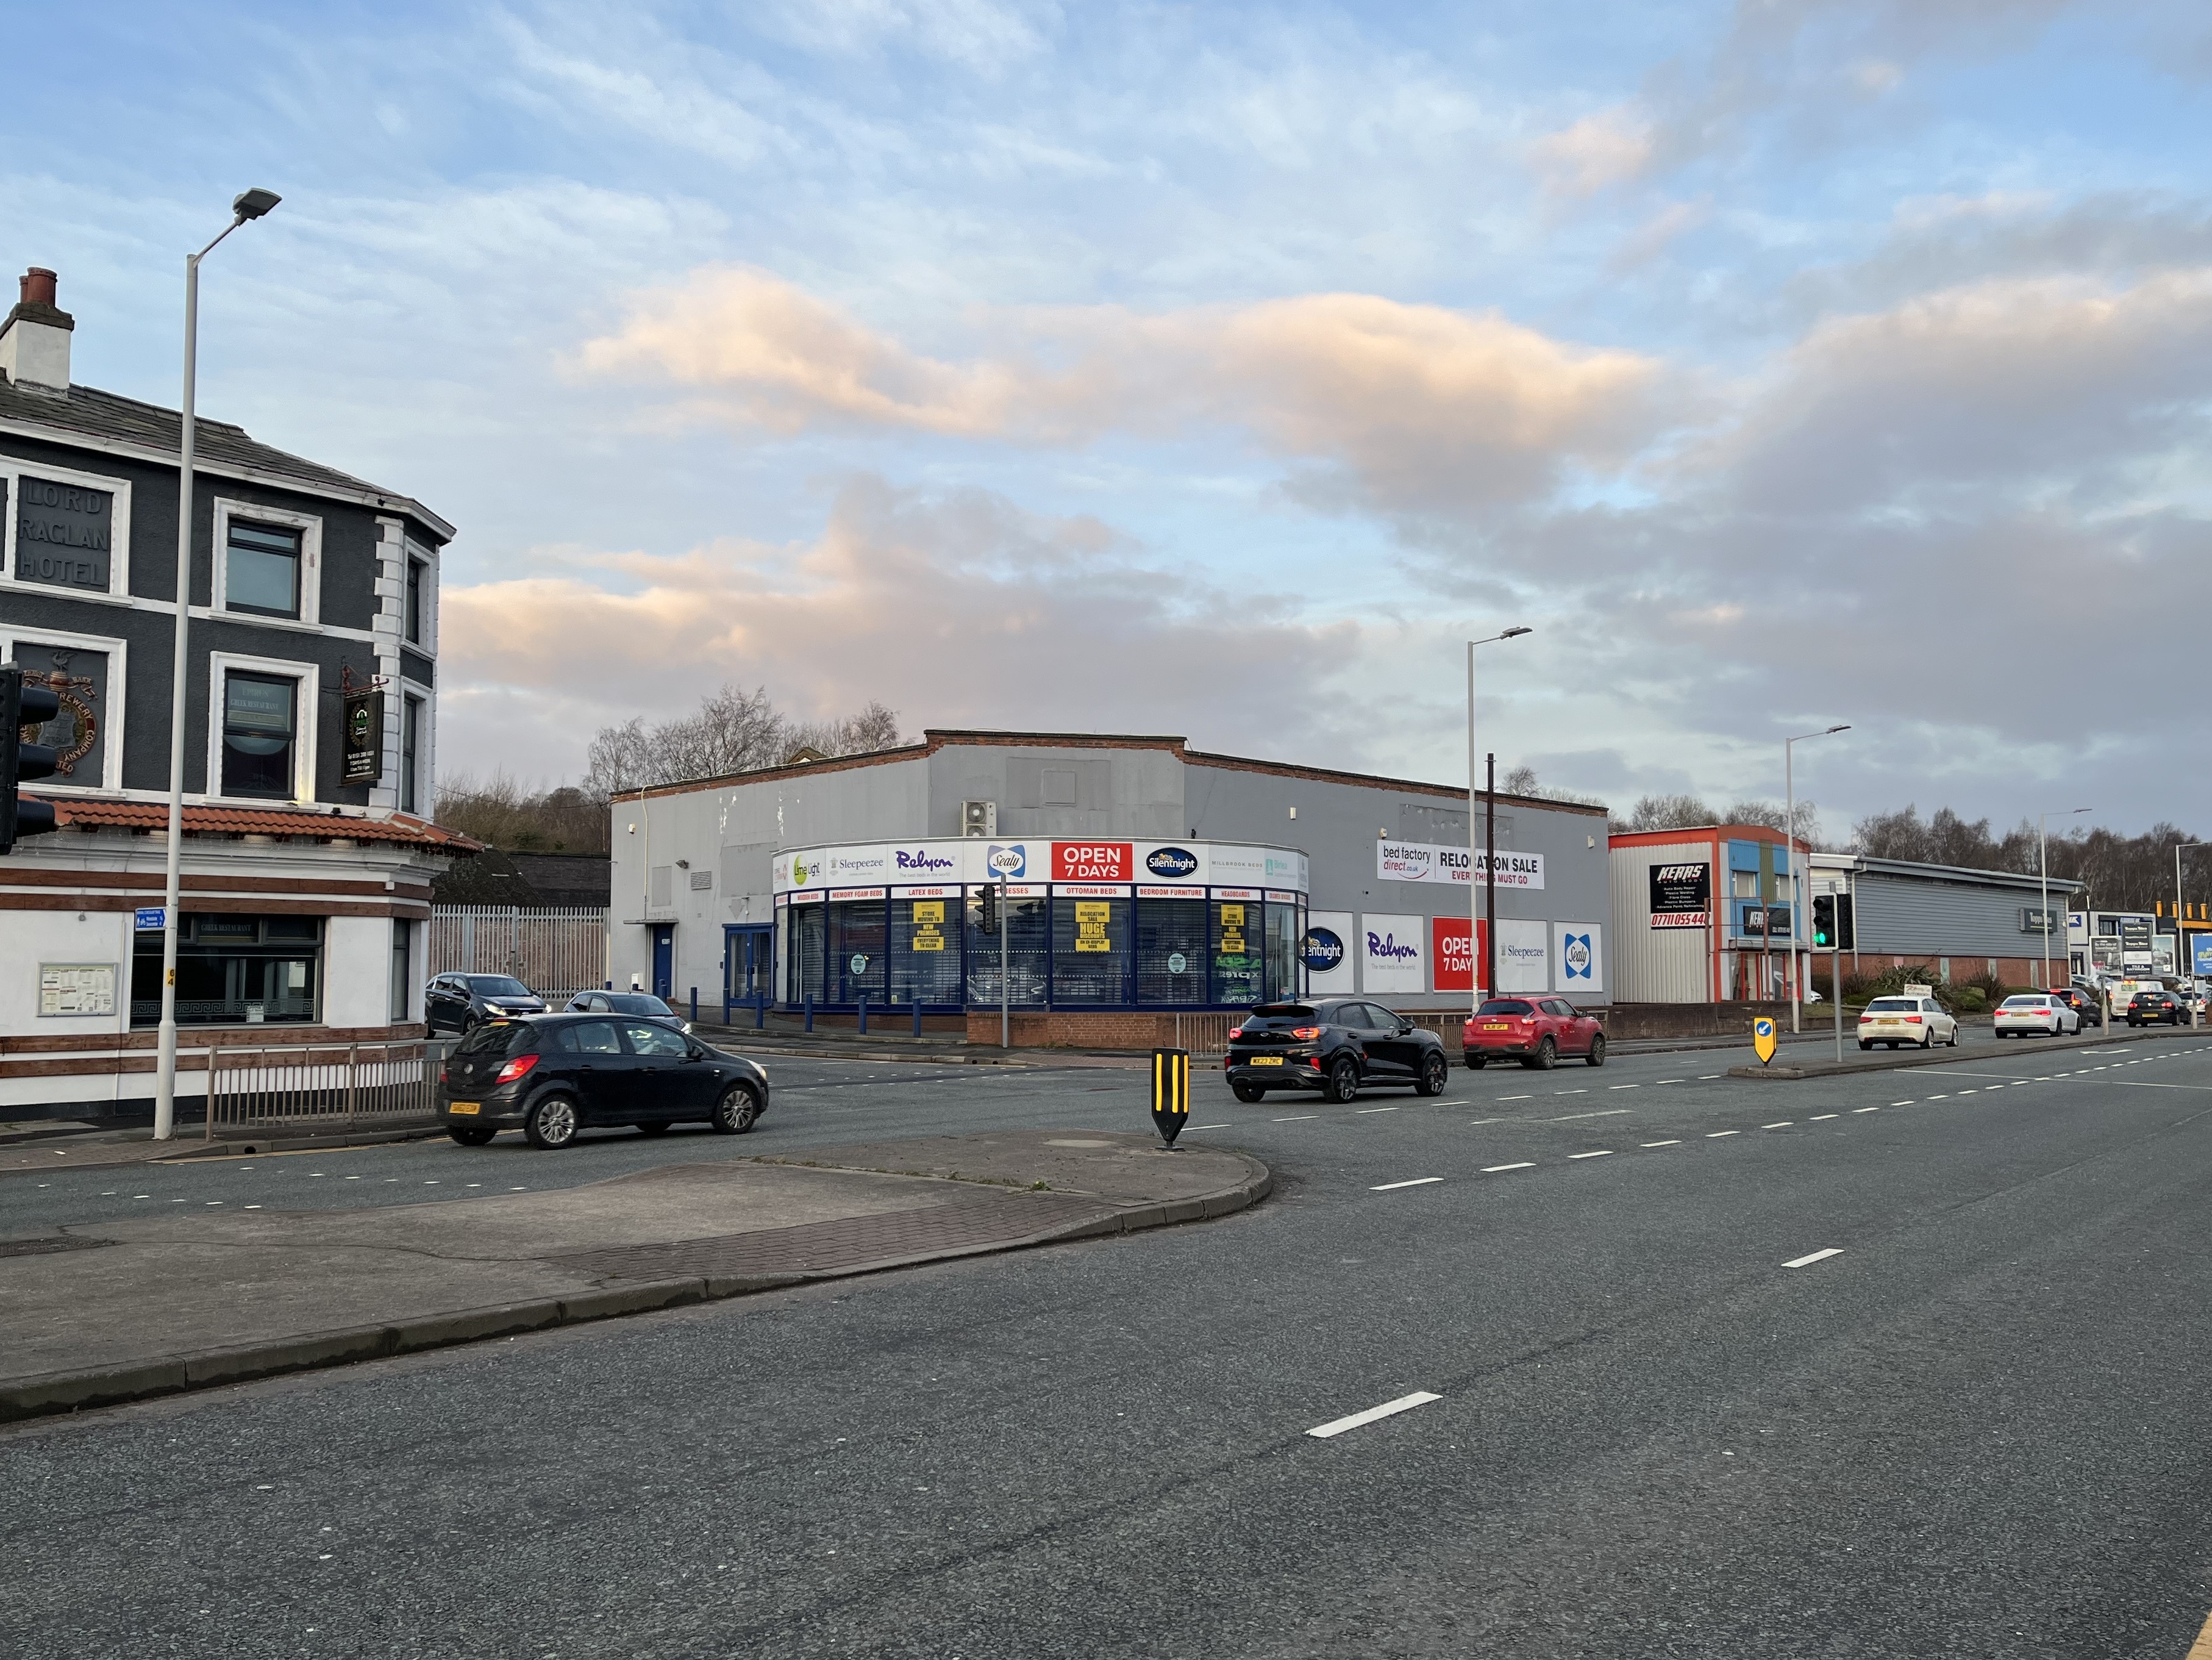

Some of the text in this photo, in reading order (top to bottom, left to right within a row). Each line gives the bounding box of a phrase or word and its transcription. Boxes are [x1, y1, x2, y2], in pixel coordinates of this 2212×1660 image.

[26, 481, 102, 513] LORD
[19, 551, 105, 586] HOTEL
[59, 692, 94, 719] REWERY
[64, 729, 95, 761] COMPANY
[896, 850, 954, 871] Relyon
[993, 854, 1019, 869] Sealy
[1063, 847, 1121, 863] OPEN
[1383, 845, 1430, 864] bed factory
[1440, 852, 1538, 873] RELOATON SALE
[794, 862, 820, 876] Lime Light
[840, 859, 883, 870] Sleepeezee
[1065, 865, 1119, 878] 7 DAYS
[1149, 857, 1195, 870] Silentnight
[1452, 871, 1528, 884] EVERTHI MUST GO
[1657, 865, 1704, 881] KERRS
[1080, 923, 1105, 934] HUGE
[1308, 943, 1341, 960] entnight
[1368, 932, 1418, 962] Relyon
[1508, 945, 1544, 959] Sleepeezee
[1443, 957, 1472, 971] 7 DAY
[1569, 946, 1588, 966] Sealy
